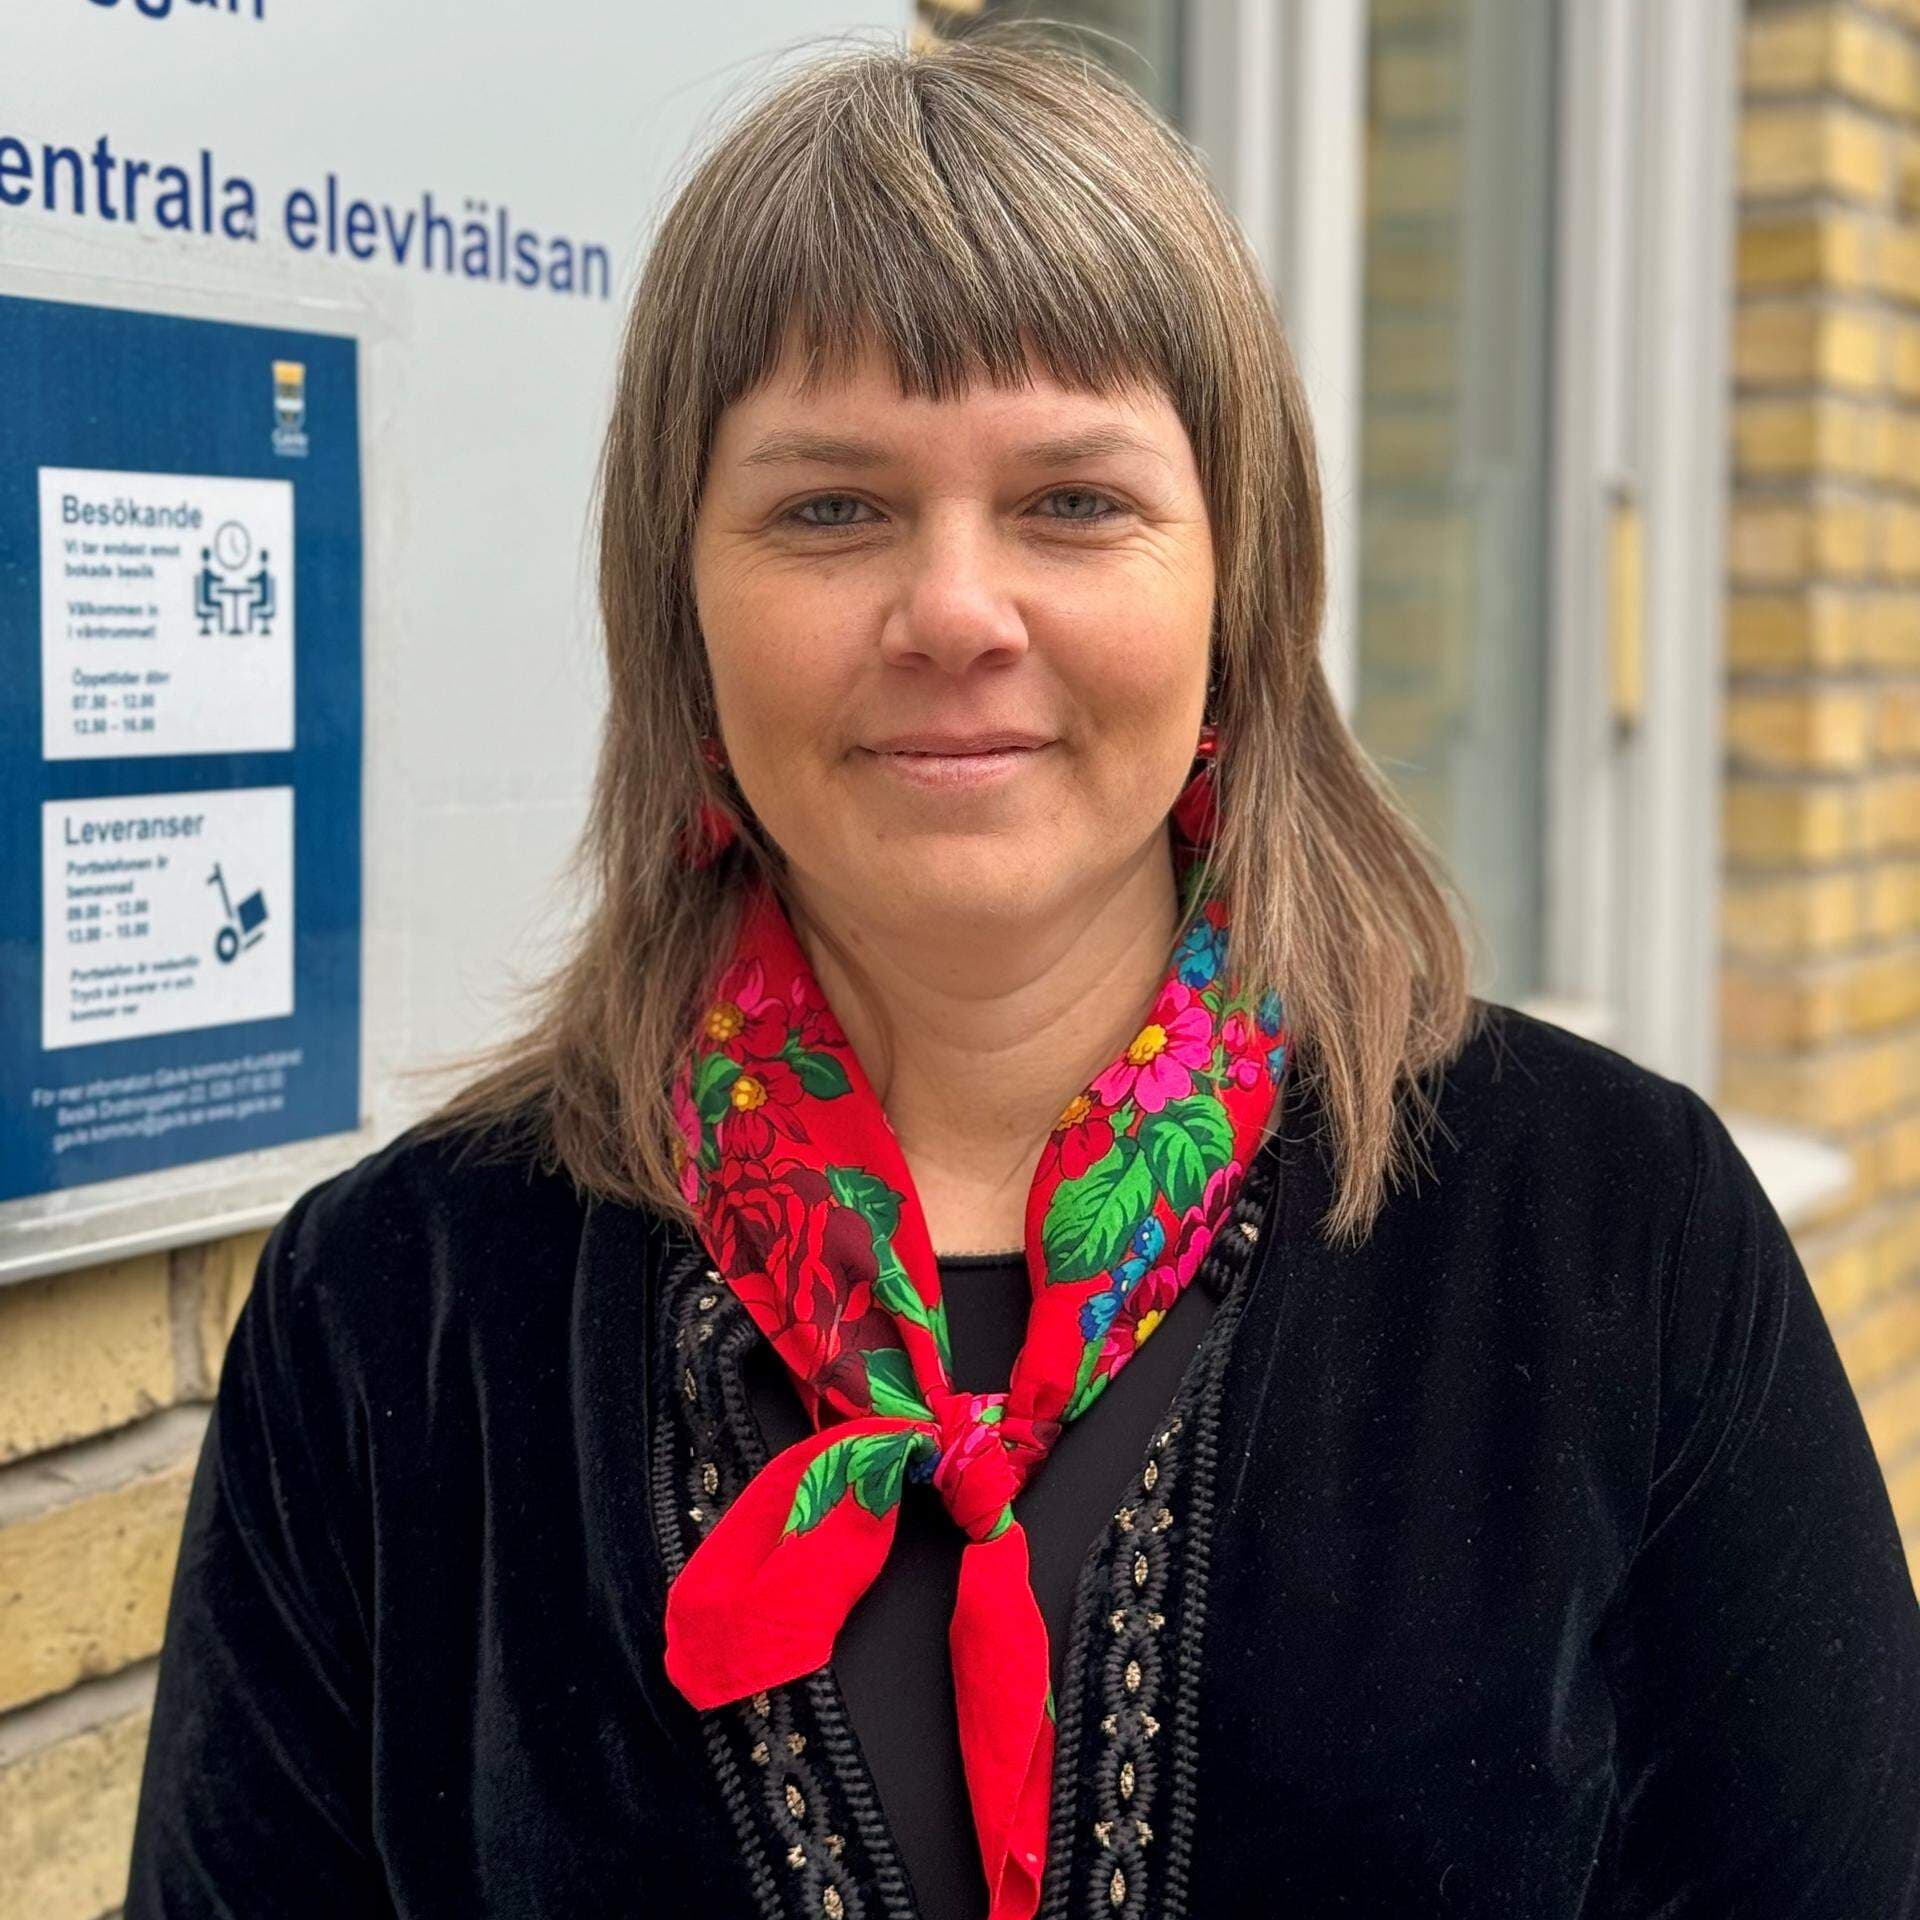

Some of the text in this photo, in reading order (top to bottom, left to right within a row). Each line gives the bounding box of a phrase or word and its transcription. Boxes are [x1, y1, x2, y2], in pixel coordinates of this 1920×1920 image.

[285, 173, 611, 298] elevhälsan
[62, 494, 203, 529] Besökande
[65, 814, 204, 846] Leveranser
